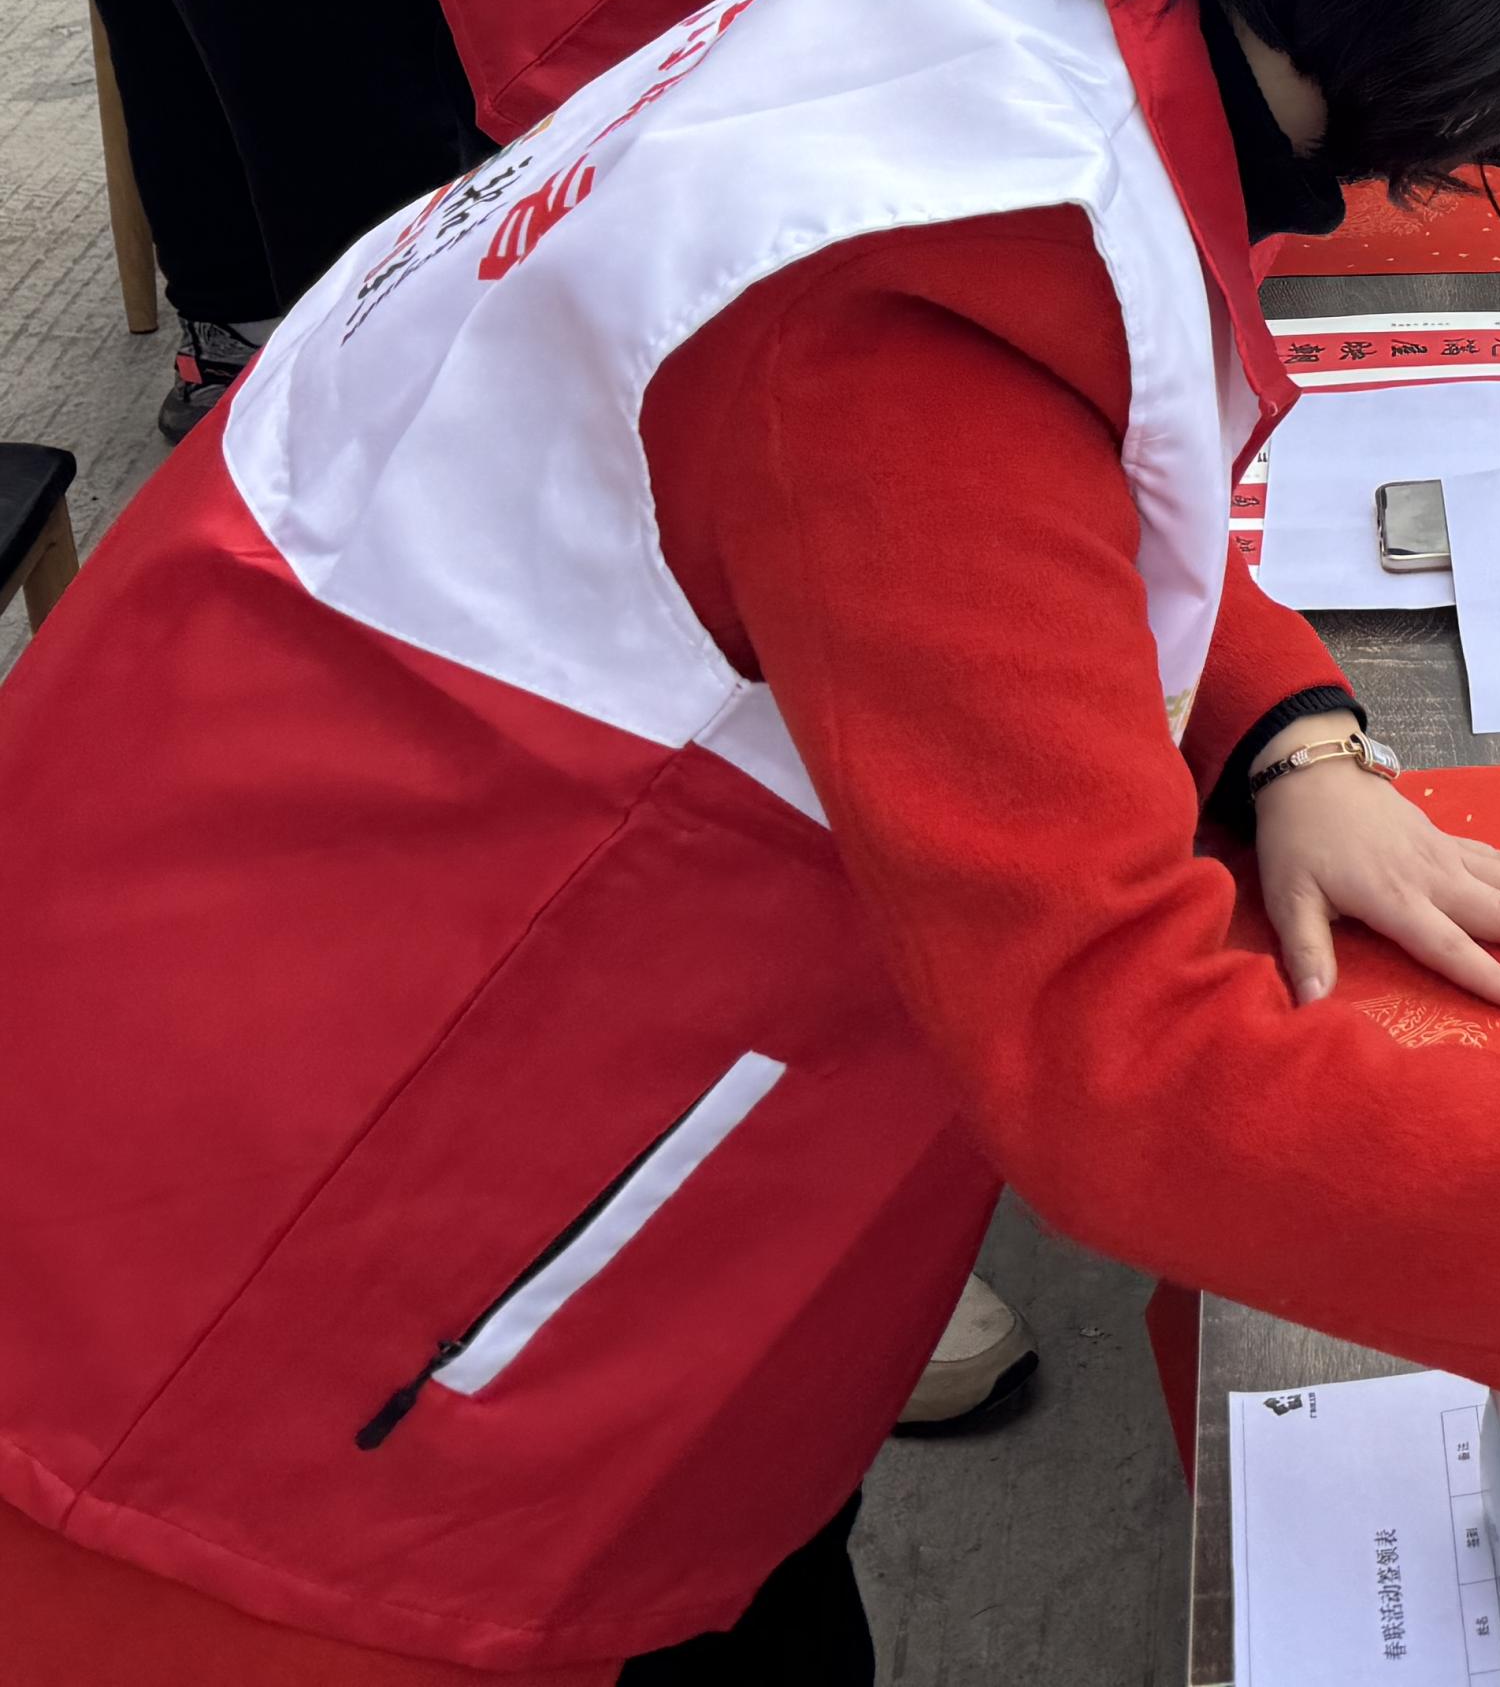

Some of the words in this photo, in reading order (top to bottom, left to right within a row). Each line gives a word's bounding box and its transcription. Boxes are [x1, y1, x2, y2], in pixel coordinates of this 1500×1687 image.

[1374, 1528, 1407, 1660] 春联活动签领表
